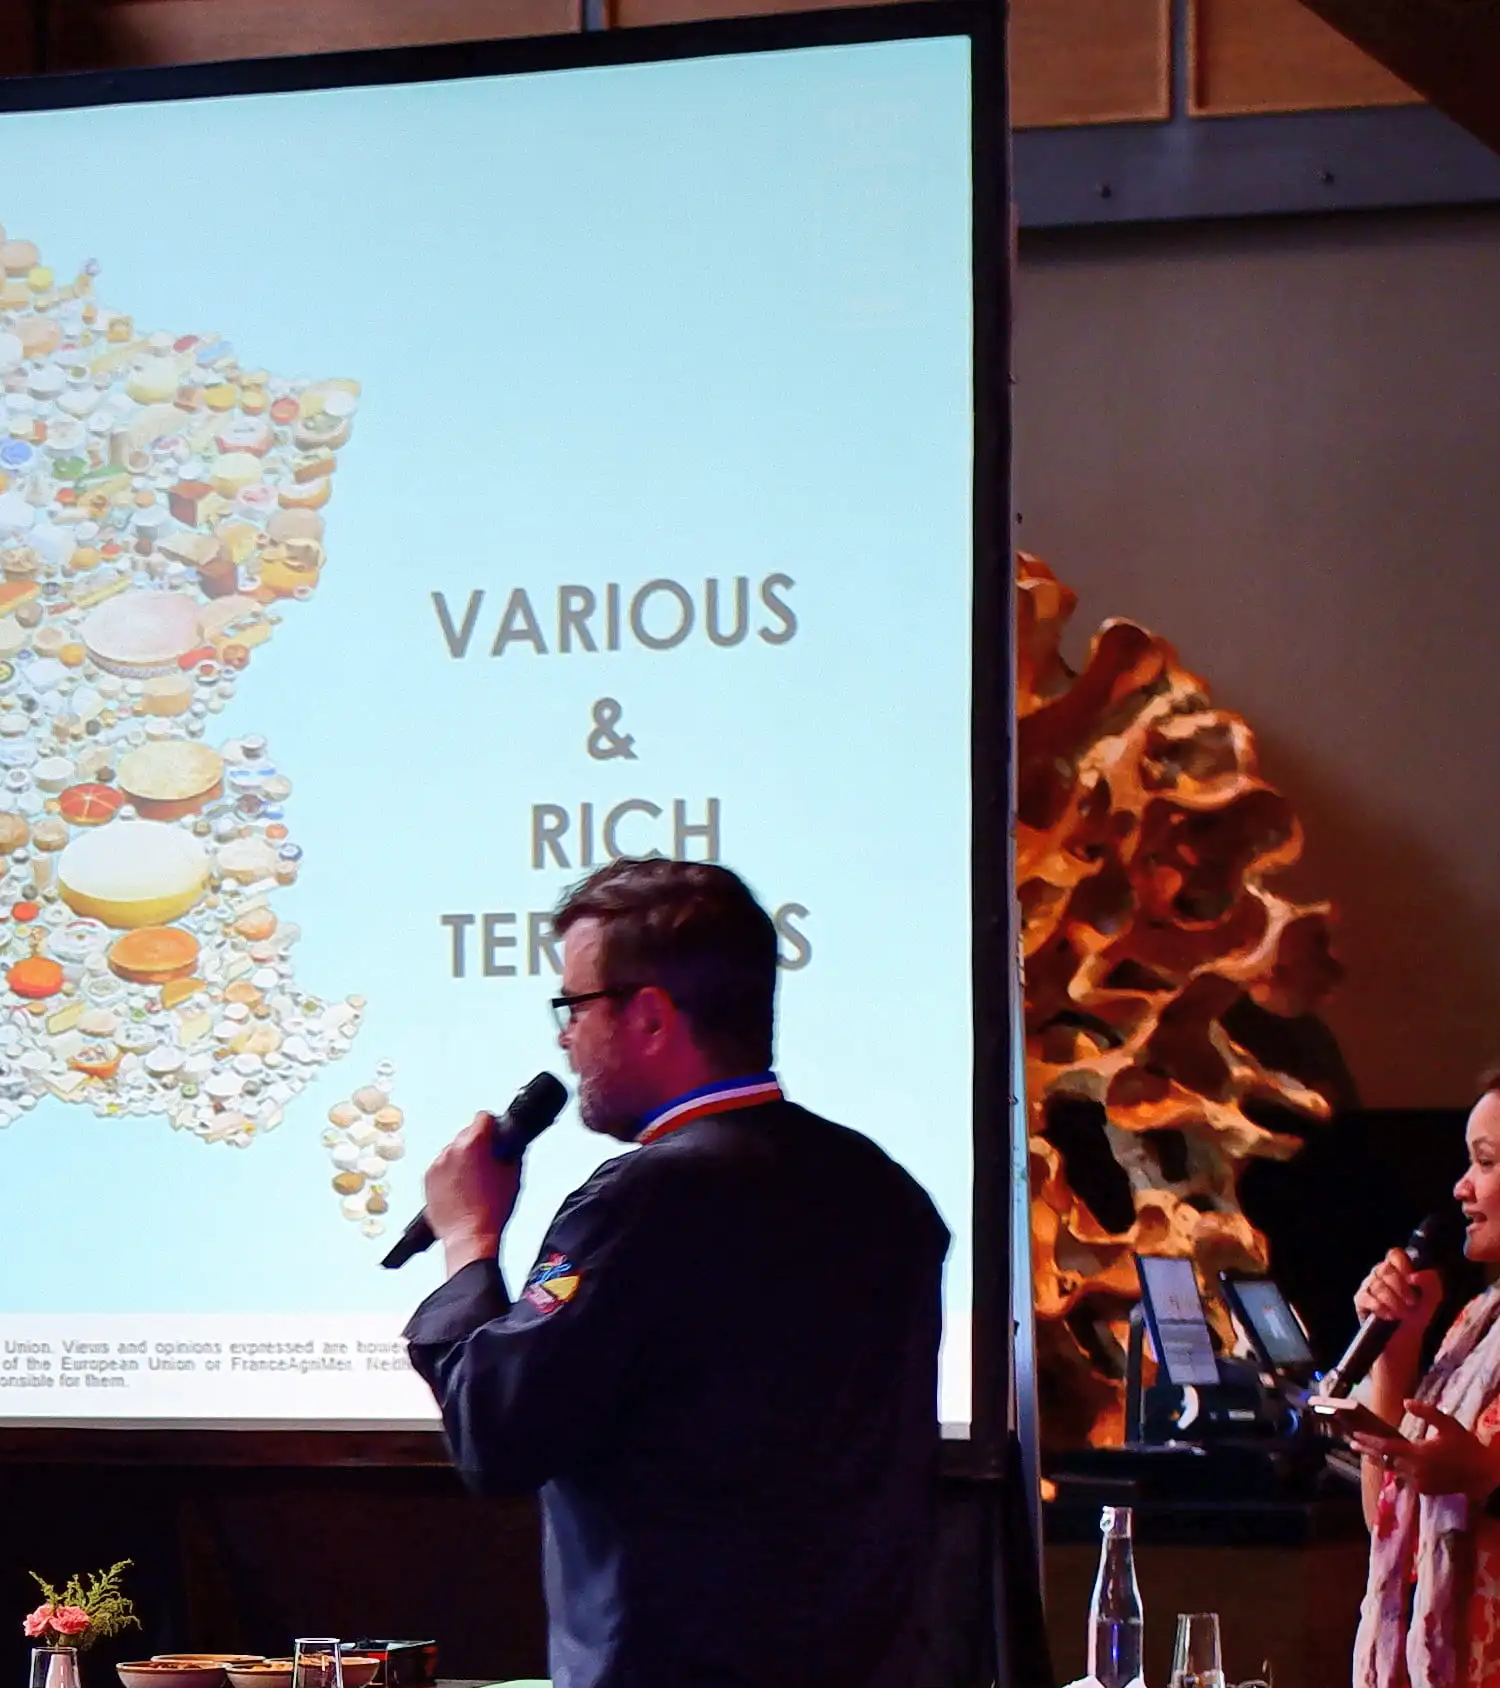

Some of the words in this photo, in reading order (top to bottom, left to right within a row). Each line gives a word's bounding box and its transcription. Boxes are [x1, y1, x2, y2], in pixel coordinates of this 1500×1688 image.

[431, 573, 798, 658] VARIOUS
[587, 697, 639, 760] &
[531, 798, 721, 870] RICH
[440, 902, 813, 978] TERS
[2, 1356, 18, 1370] of
[27, 1356, 51, 1370] the
[61, 1356, 139, 1373] European
[149, 1357, 195, 1371] Union
[205, 1359, 220, 1371] or
[59, 1373, 80, 1387] for
[85, 1373, 129, 1387] them.
[62, 1340, 110, 1354] Views
[117, 1340, 147, 1354] and
[155, 1341, 222, 1356] opinions
[229, 1340, 314, 1357] expressed
[322, 1342, 348, 1354] are
